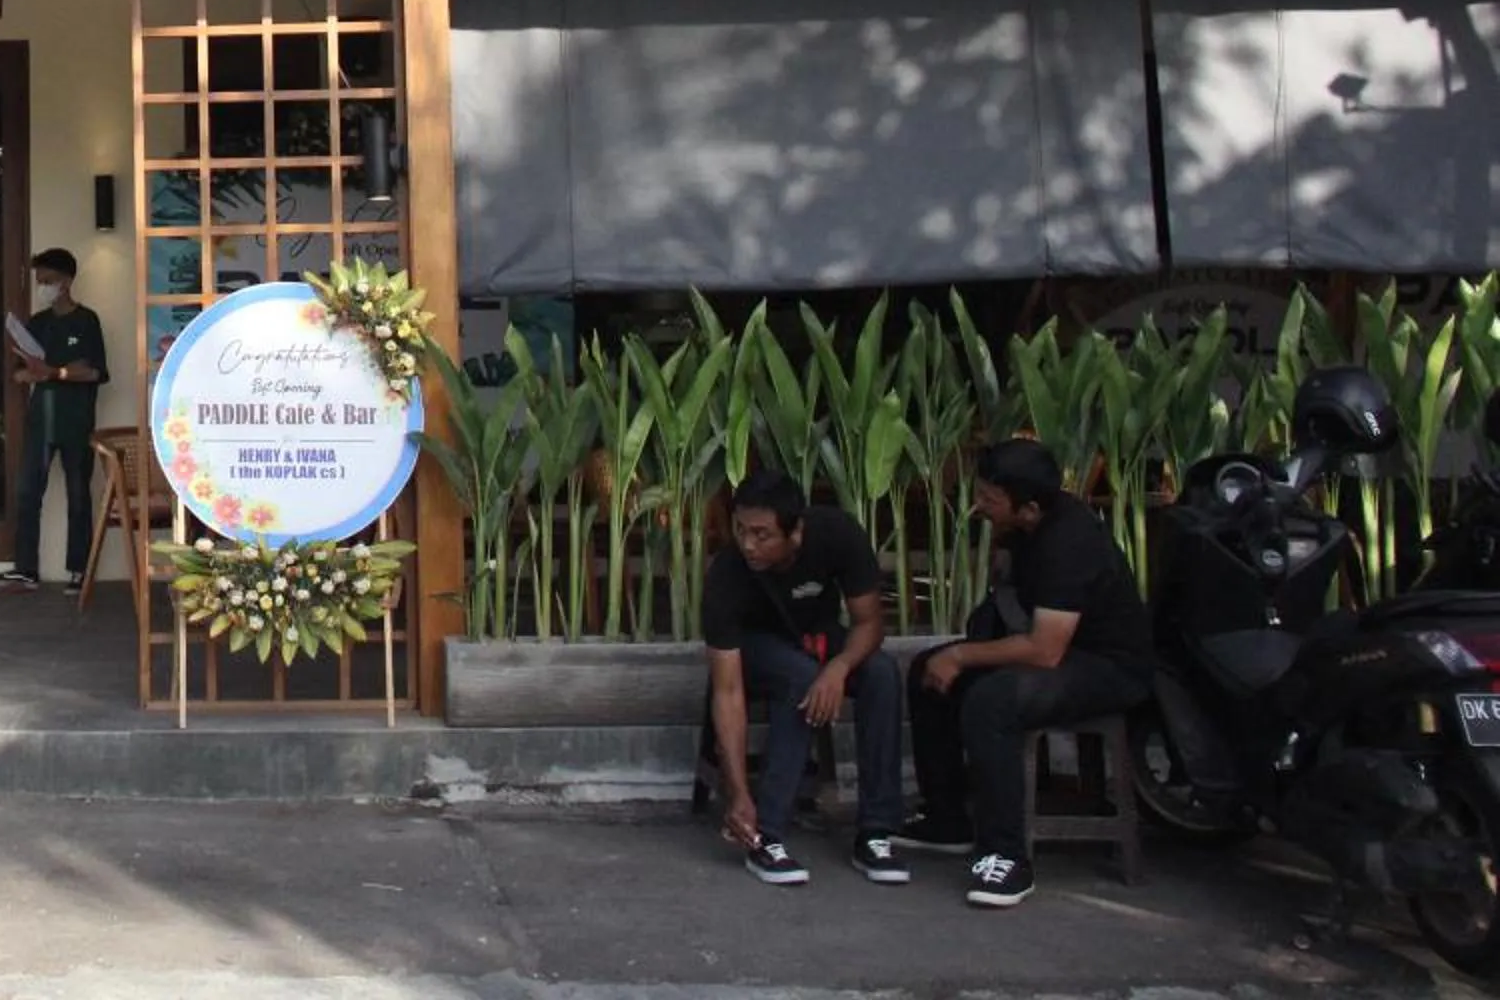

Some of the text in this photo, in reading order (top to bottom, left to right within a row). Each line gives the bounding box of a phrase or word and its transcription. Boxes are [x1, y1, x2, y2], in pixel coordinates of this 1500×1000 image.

[197, 403, 269, 425] PADDLE
[321, 403, 337, 425] &
[343, 404, 378, 425] Bar
[238, 448, 337, 463] HENRY & IVANA
[239, 466, 262, 478] the
[265, 466, 317, 479] KOPLAK
[1462, 700, 1490, 720] DK
